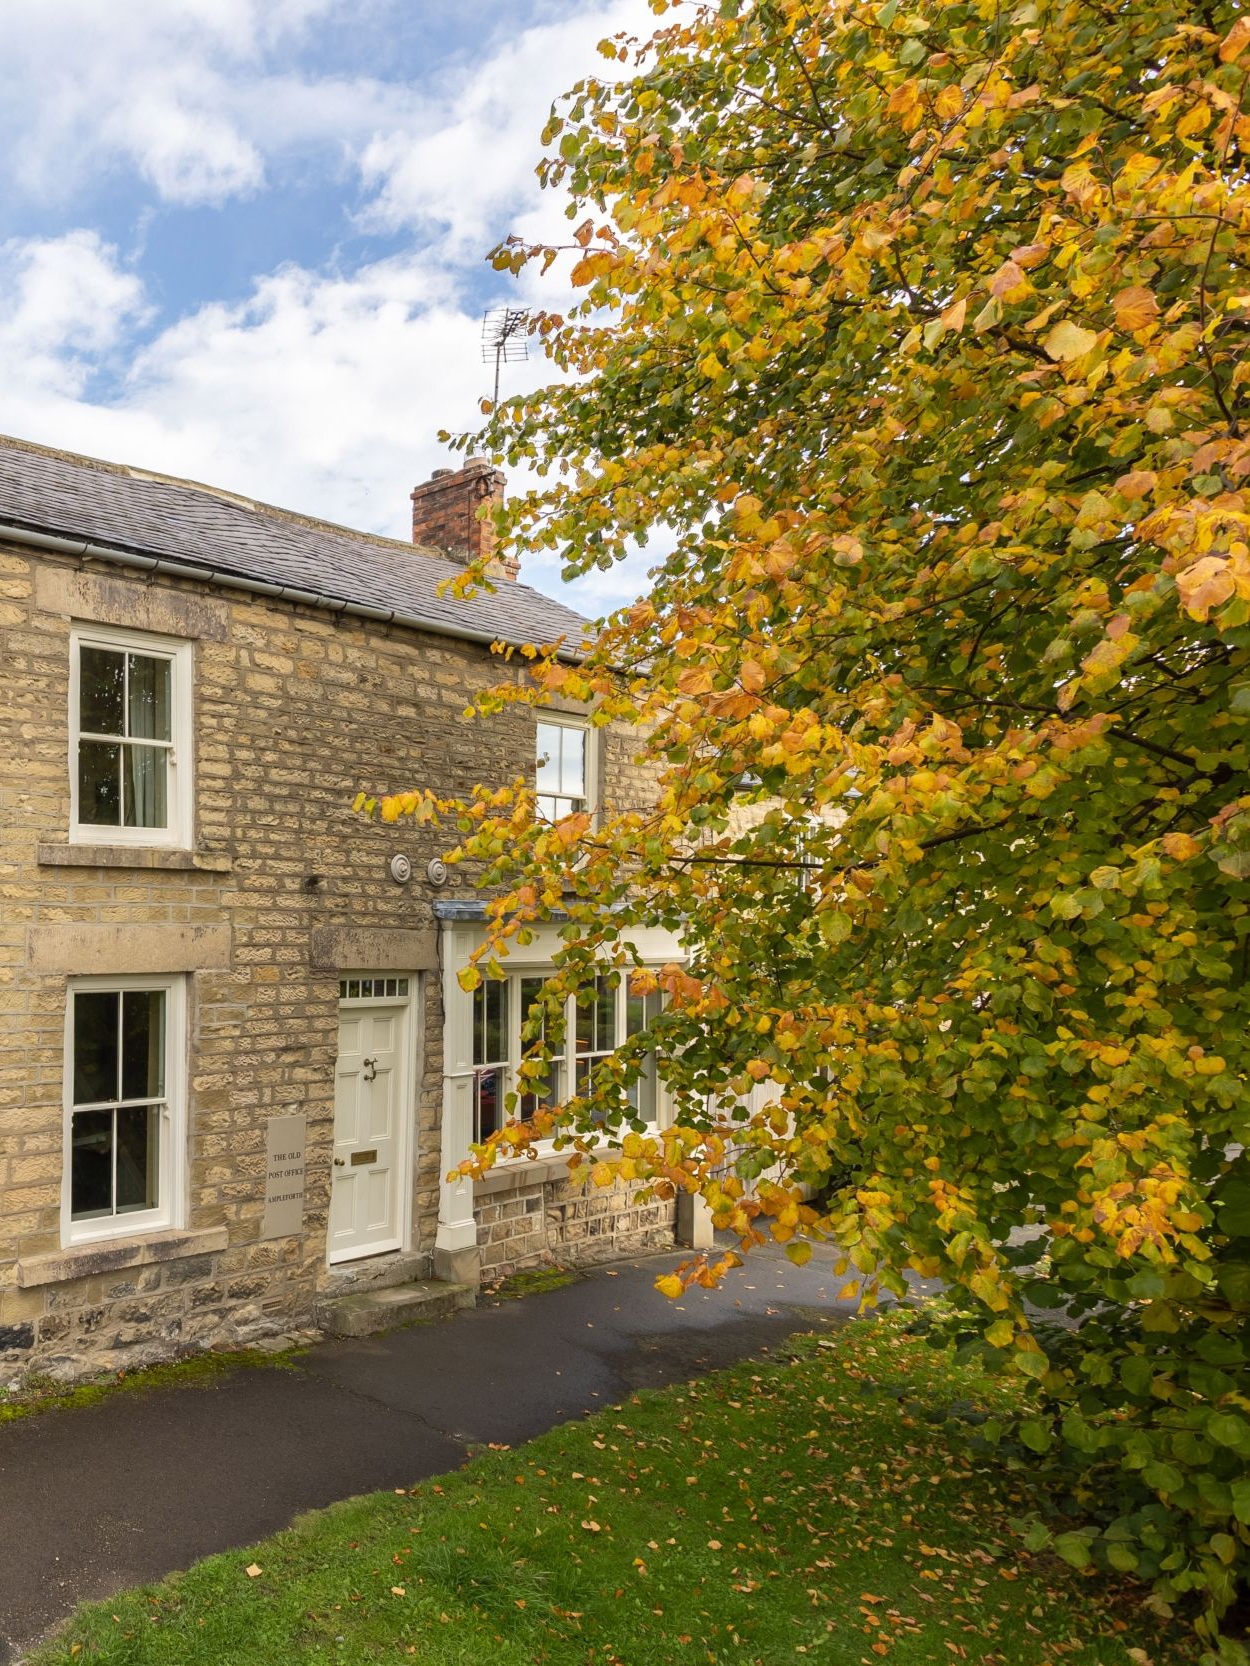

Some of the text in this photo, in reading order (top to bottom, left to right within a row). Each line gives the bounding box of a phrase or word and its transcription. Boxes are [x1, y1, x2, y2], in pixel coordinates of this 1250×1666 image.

[273, 1152, 301, 1162] THE OLD
[268, 1168, 303, 1179] POST OFFICE
[268, 1192, 303, 1203] AMPLEFORTH
